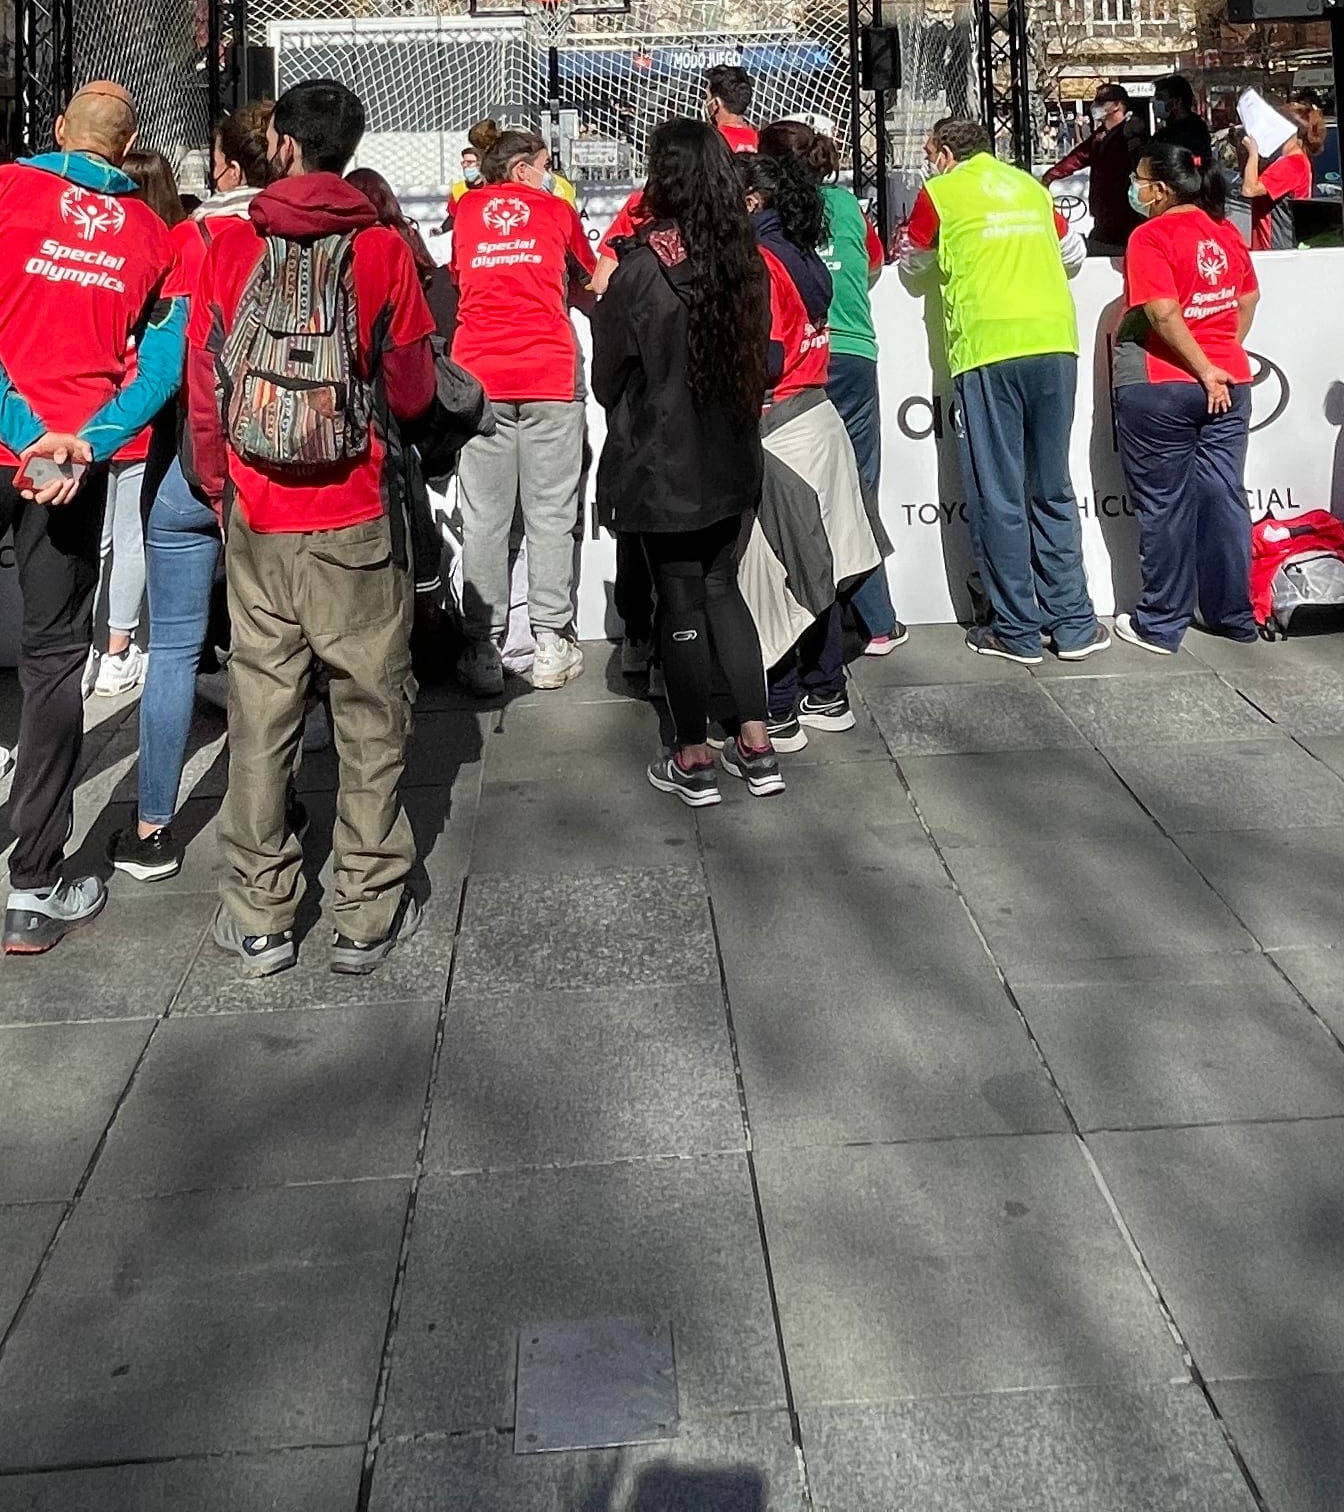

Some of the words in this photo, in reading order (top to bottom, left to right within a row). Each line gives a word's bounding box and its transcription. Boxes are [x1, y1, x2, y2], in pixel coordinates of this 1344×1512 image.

[673, 52, 706, 69] MODO
[40, 239, 126, 271] Special
[475, 237, 536, 255] Special
[471, 251, 543, 270] Olympics
[25, 257, 126, 293] Olympics
